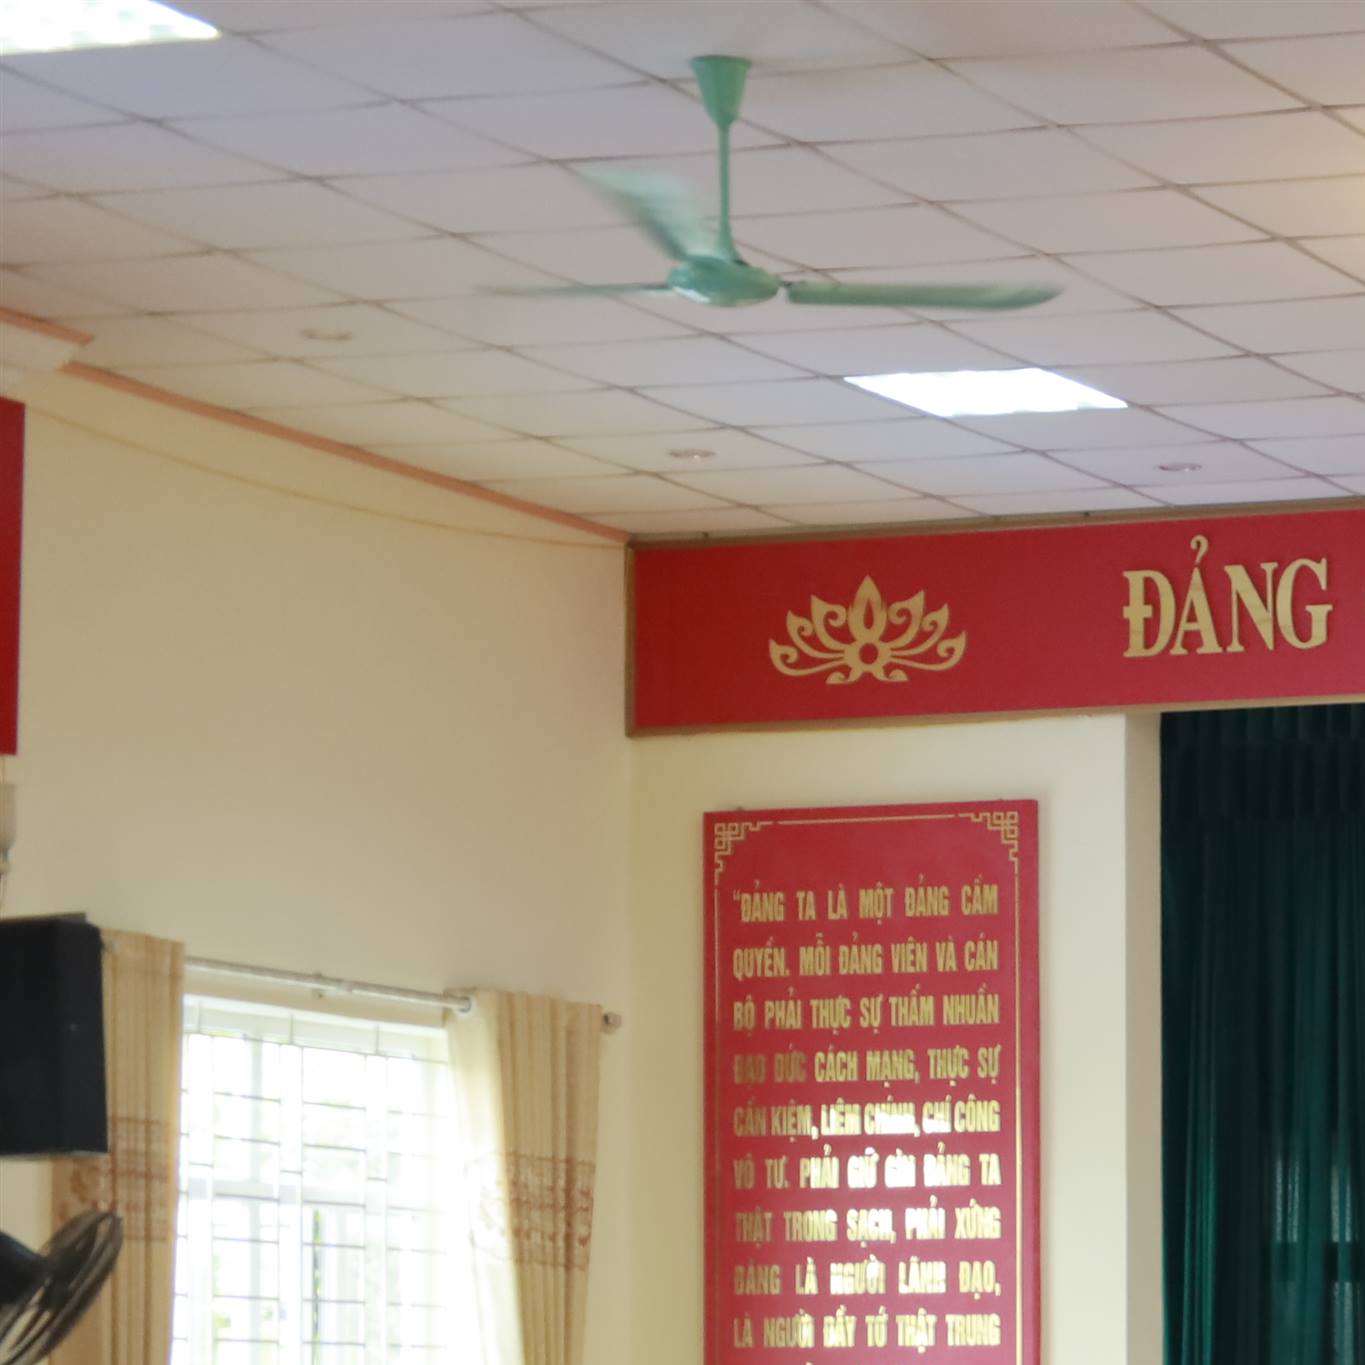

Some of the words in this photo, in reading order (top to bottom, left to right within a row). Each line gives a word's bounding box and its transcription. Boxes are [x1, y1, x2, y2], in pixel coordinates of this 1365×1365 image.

[1122, 535, 1332, 657] ĐẢNG
[797, 890, 817, 920] TA
[828, 883, 848, 920] LÀ
[859, 882, 893, 927] MỘT
[905, 873, 949, 917] ĐẢNG
[961, 873, 999, 916] CẦM
[733, 937, 790, 981] QUYỀN.
[800, 932, 832, 976] MỖI
[839, 931, 883, 975] ĐẢNG
[892, 936, 928, 973] VIÊN
[936, 936, 957, 973] VÀ
[965, 932, 999, 972] CÁN
[734, 994, 757, 1036] BỘ
[765, 986, 802, 1030] PHẢI
[811, 996, 851, 1036] THỰC
[860, 994, 884, 1034] SỰ
[889, 984, 934, 1027] THẤM
[943, 983, 999, 1024] NHUẦN
[815, 1044, 858, 1083] CÁCH
[866, 1049, 920, 1088] MẠNG,
[928, 1046, 970, 1087] THỰC
[978, 1046, 1003, 1085] SỰ
[771, 1099, 819, 1143] KIỆM,
[821, 1097, 862, 1136] LIÊM
[923, 1094, 952, 1133] CHÍ
[954, 1093, 1000, 1133] CÔNG
[734, 1153, 755, 1189] VÔ
[765, 1155, 790, 1189] TƯ.
[800, 1144, 840, 1189] PHẢI
[848, 1147, 879, 1188] GIỮ
[924, 1141, 971, 1187] ĐẢNG
[978, 1154, 1001, 1186] TA
[736, 1206, 772, 1248] THẬT
[784, 1209, 838, 1242] TRONG
[847, 1208, 896, 1248] SẠCH,
[905, 1194, 947, 1240] PHẢI
[955, 1197, 1001, 1239] XỨNG
[795, 1256, 819, 1296] LÀ
[830, 1253, 887, 1296] NGƯỜI
[898, 1256, 947, 1293] LÃNH
[959, 1260, 1000, 1300] ĐẠO,
[734, 1312, 754, 1348] LÀ
[763, 1308, 815, 1349] NGƯỜI
[865, 1305, 888, 1347] TỚ
[896, 1307, 937, 1353] THẬT
[946, 1314, 1001, 1346] TRUNG
